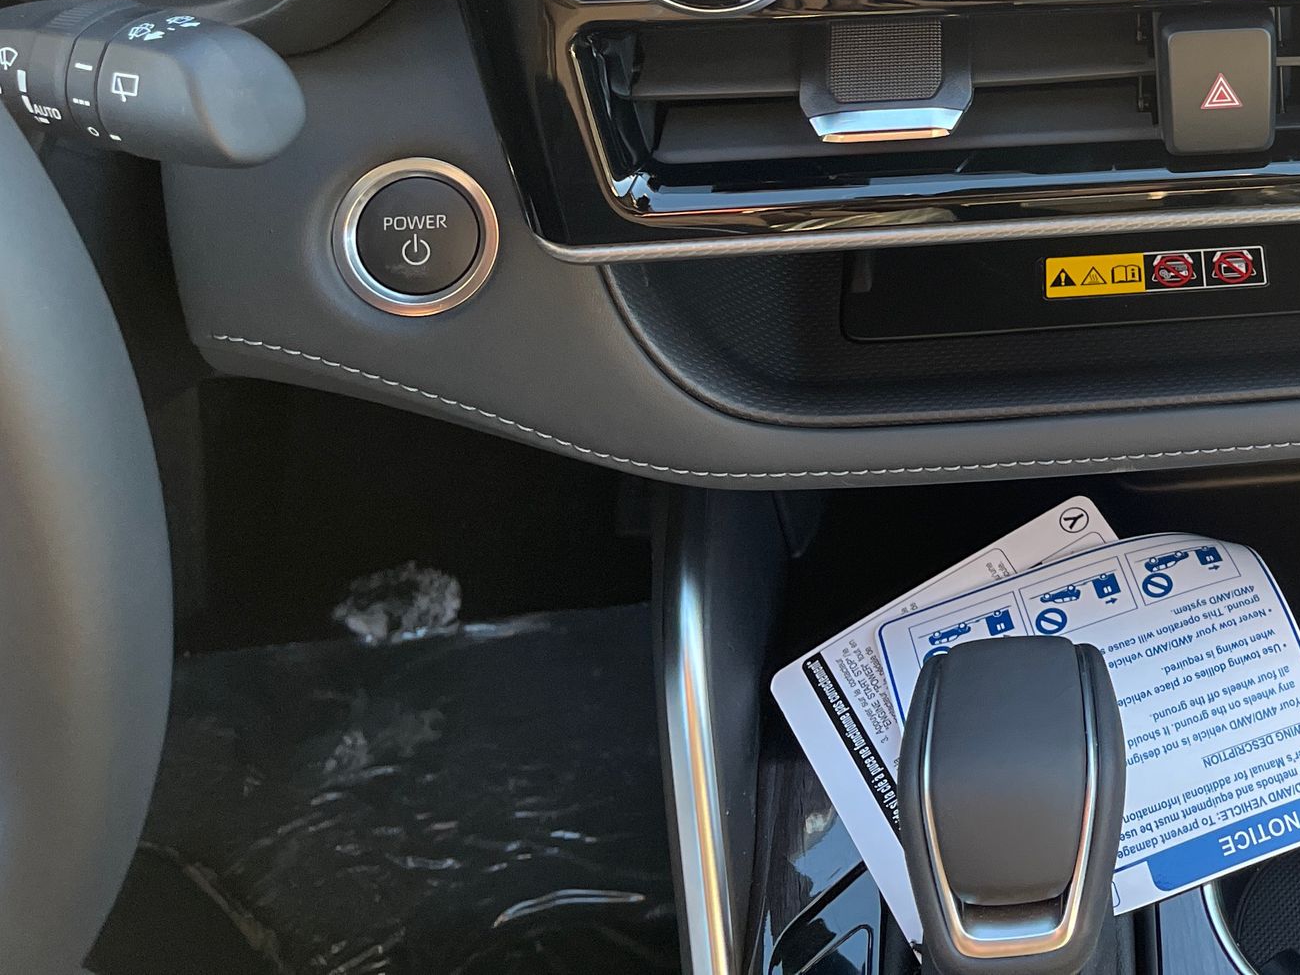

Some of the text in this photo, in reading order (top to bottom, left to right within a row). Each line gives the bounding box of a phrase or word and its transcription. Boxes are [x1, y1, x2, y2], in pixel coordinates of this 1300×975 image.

[34, 103, 62, 120] AUTO
[384, 215, 447, 231] POWER
[1172, 583, 1254, 615] 4WD/AWD system.
[1107, 608, 1266, 670] Never tow your 4WD/AWD vehicle
[1115, 642, 1281, 709] Use towing dollies or place vehicle
[1228, 705, 1278, 730] 4WD/AWD
[1180, 736, 1191, 747] is
[1191, 722, 1228, 743] vehicle
[1127, 745, 1161, 767] design
[1161, 740, 1180, 754] not
[1201, 732, 1274, 768] DESCRIPTION
[1232, 769, 1248, 783] for
[1248, 756, 1285, 778] Manual
[1181, 775, 1232, 803] additional
[1255, 767, 1298, 791] methods
[1234, 783, 1255, 799] and
[1179, 789, 1234, 818] equipment
[1215, 794, 1267, 822] VEHICLE:
[1138, 822, 1153, 835] be
[1153, 811, 1180, 829] must
[1158, 818, 1200, 843] prevent
[1200, 814, 1215, 828] To
[1117, 827, 1138, 843] use
[1218, 811, 1300, 855] NOTICE
[1115, 835, 1159, 860] damage
